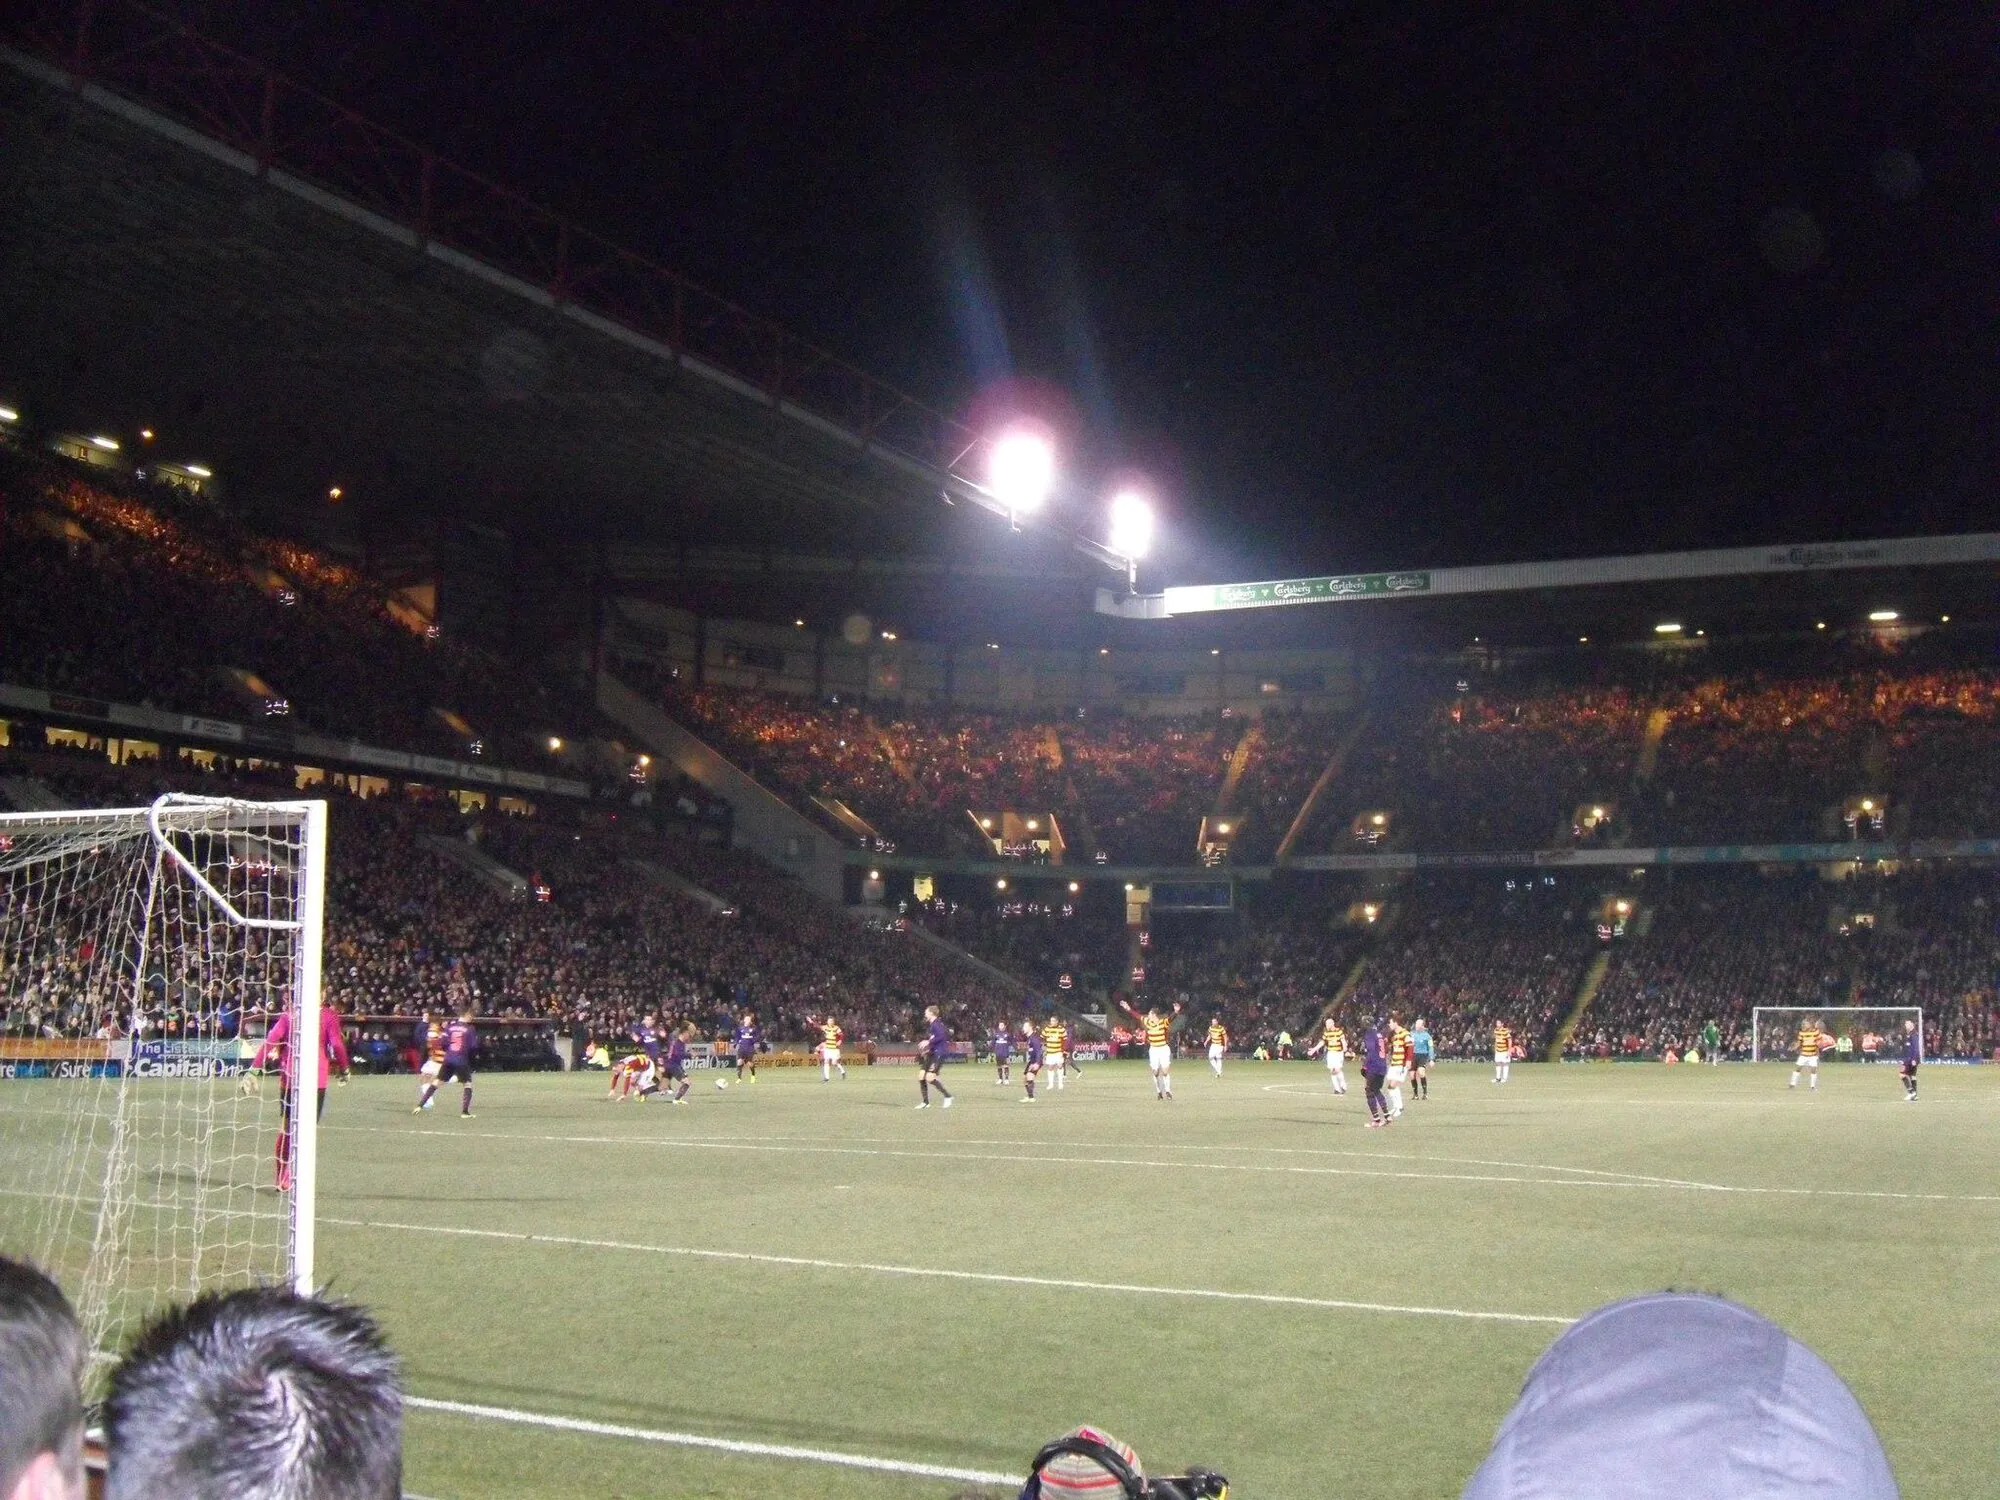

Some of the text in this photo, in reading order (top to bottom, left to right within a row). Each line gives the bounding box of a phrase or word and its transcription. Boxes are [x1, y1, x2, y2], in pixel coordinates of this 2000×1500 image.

[1274, 582, 1311, 598] Carlsberg
[1329, 578, 1366, 594] Carlsberg
[1386, 574, 1424, 591] Carlsberg
[138, 1043, 162, 1054] The
[682, 1055, 729, 1070] pitalOne
